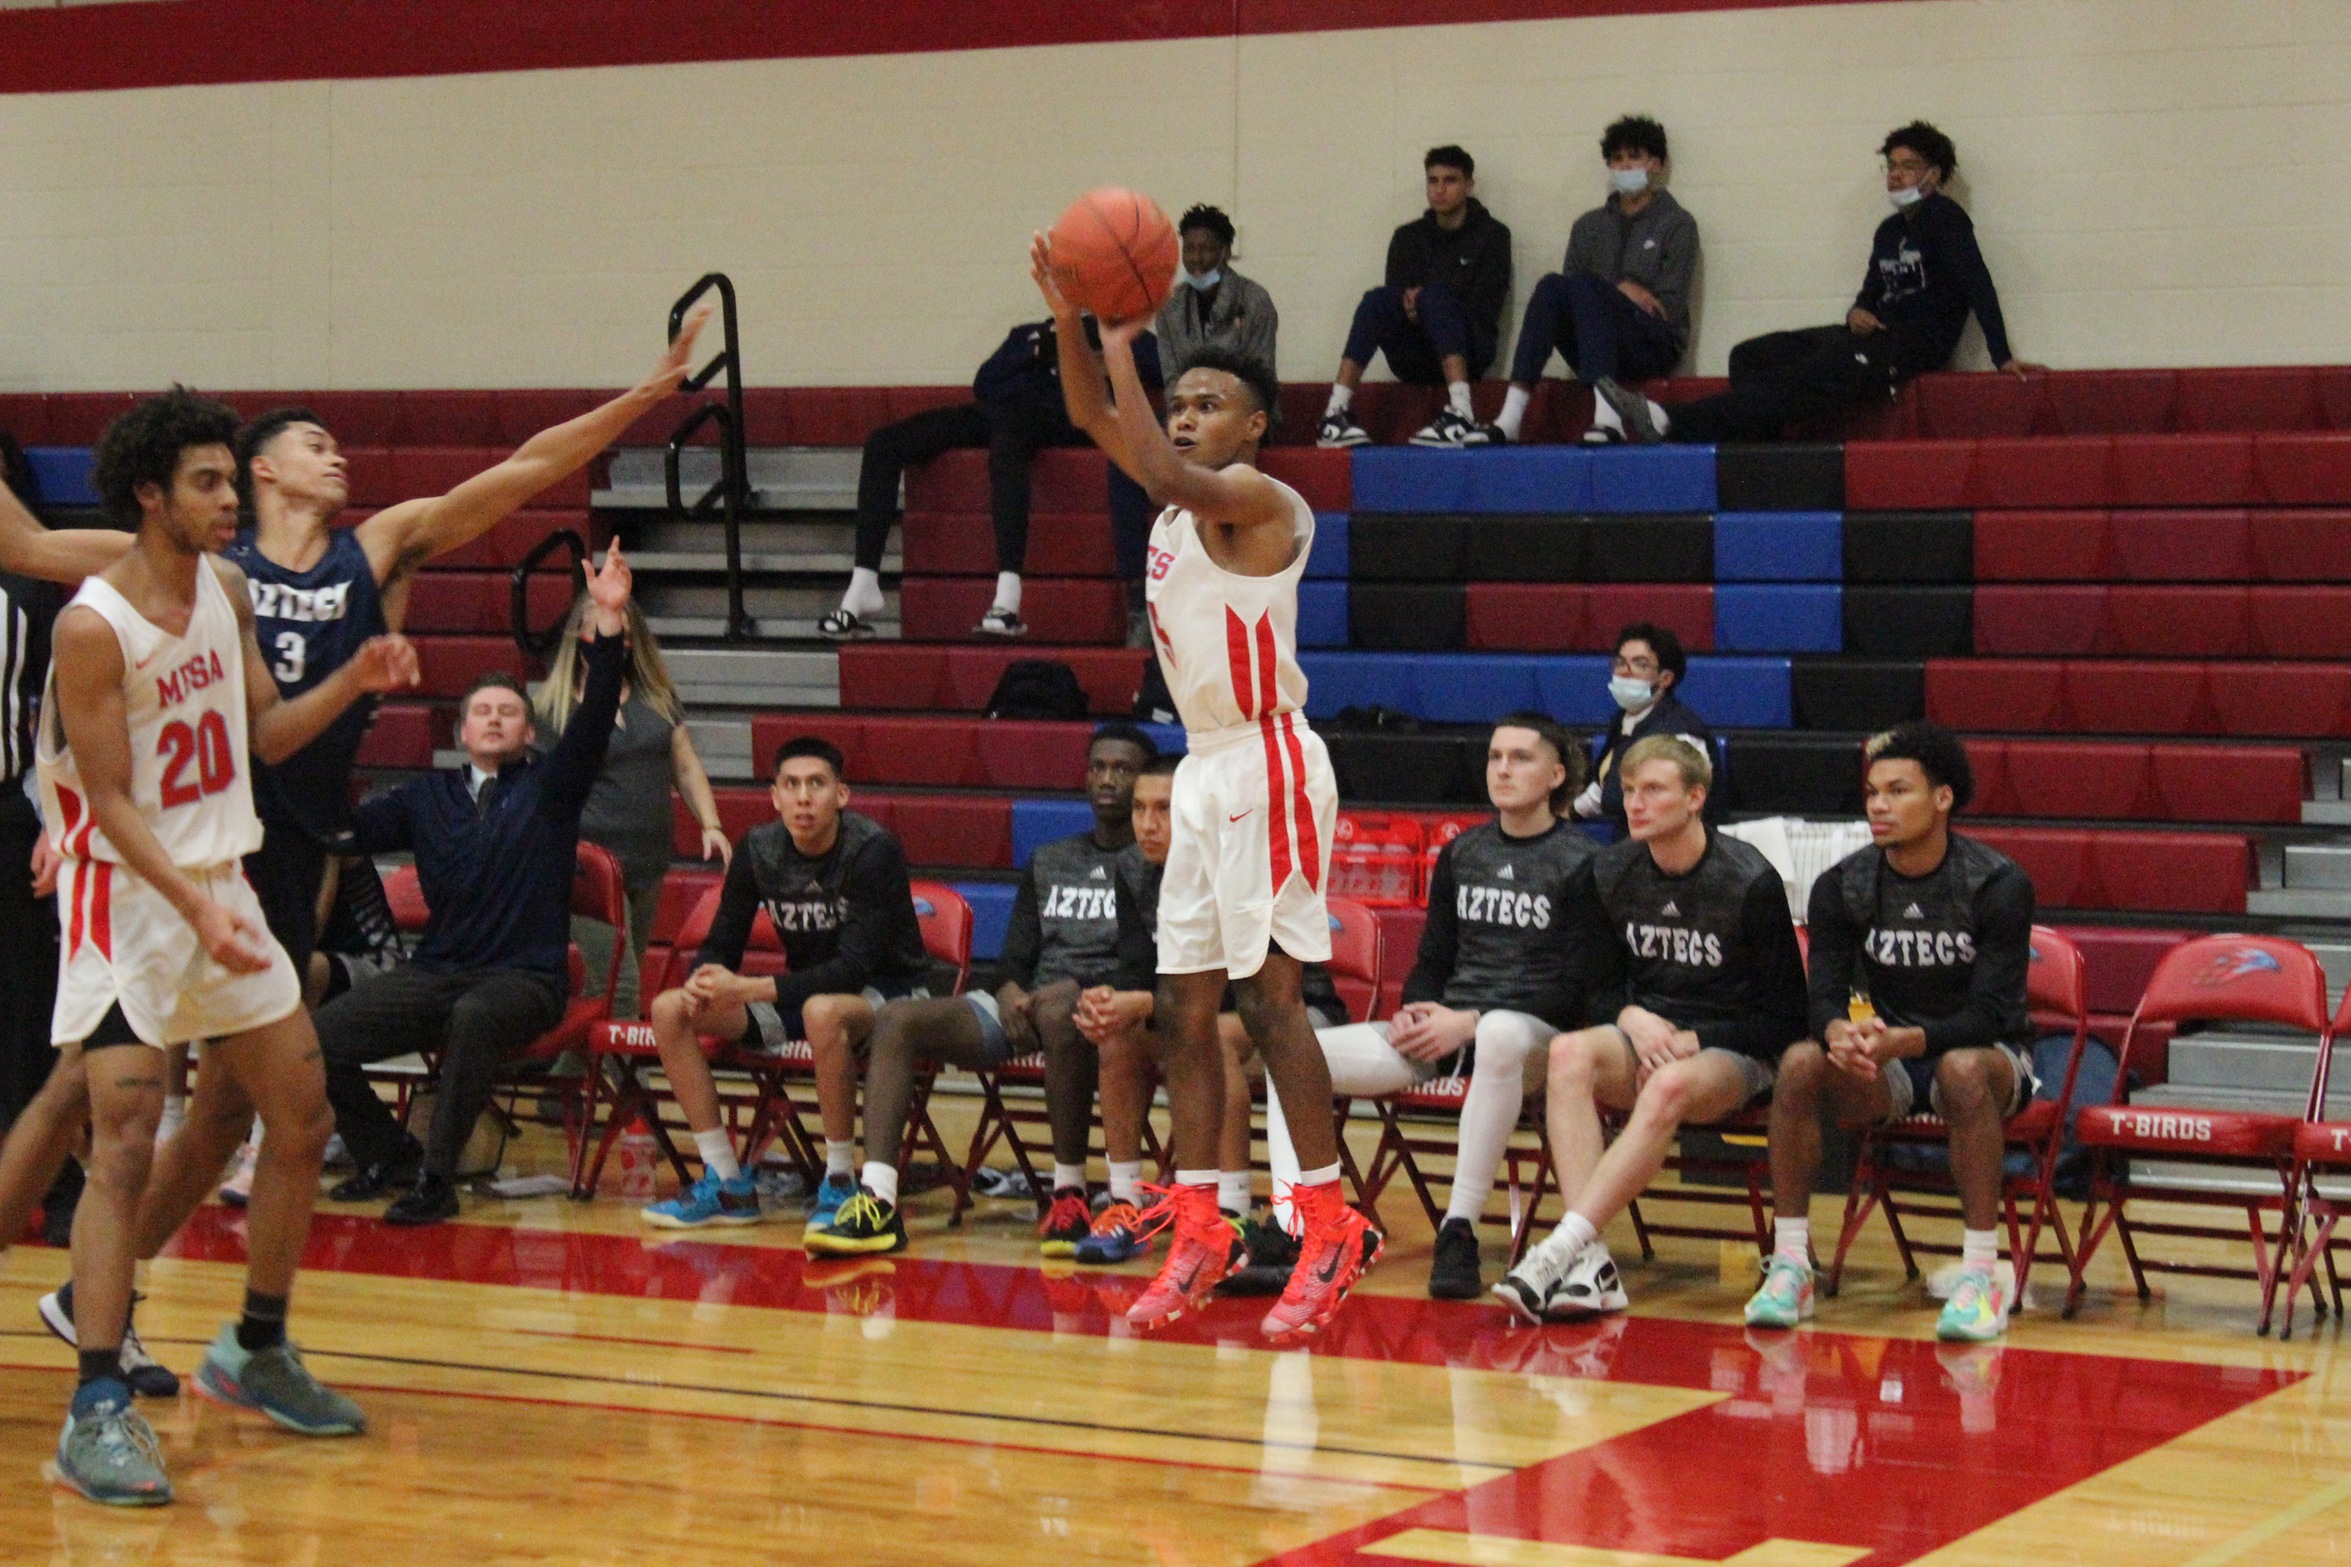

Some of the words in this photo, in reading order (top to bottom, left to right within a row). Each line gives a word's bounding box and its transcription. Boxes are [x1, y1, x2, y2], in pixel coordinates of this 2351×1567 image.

[274, 631, 306, 683] 3
[156, 709, 236, 811] 20
[1043, 884, 1117, 920] AZTEC
[1457, 884, 1551, 930] AZTECS
[1626, 921, 1723, 968] AZTECS
[1865, 927, 1977, 967] AZTECS
[608, 1024, 657, 1047] T-BIR
[2109, 1112, 2212, 1142] T-BIRDS
